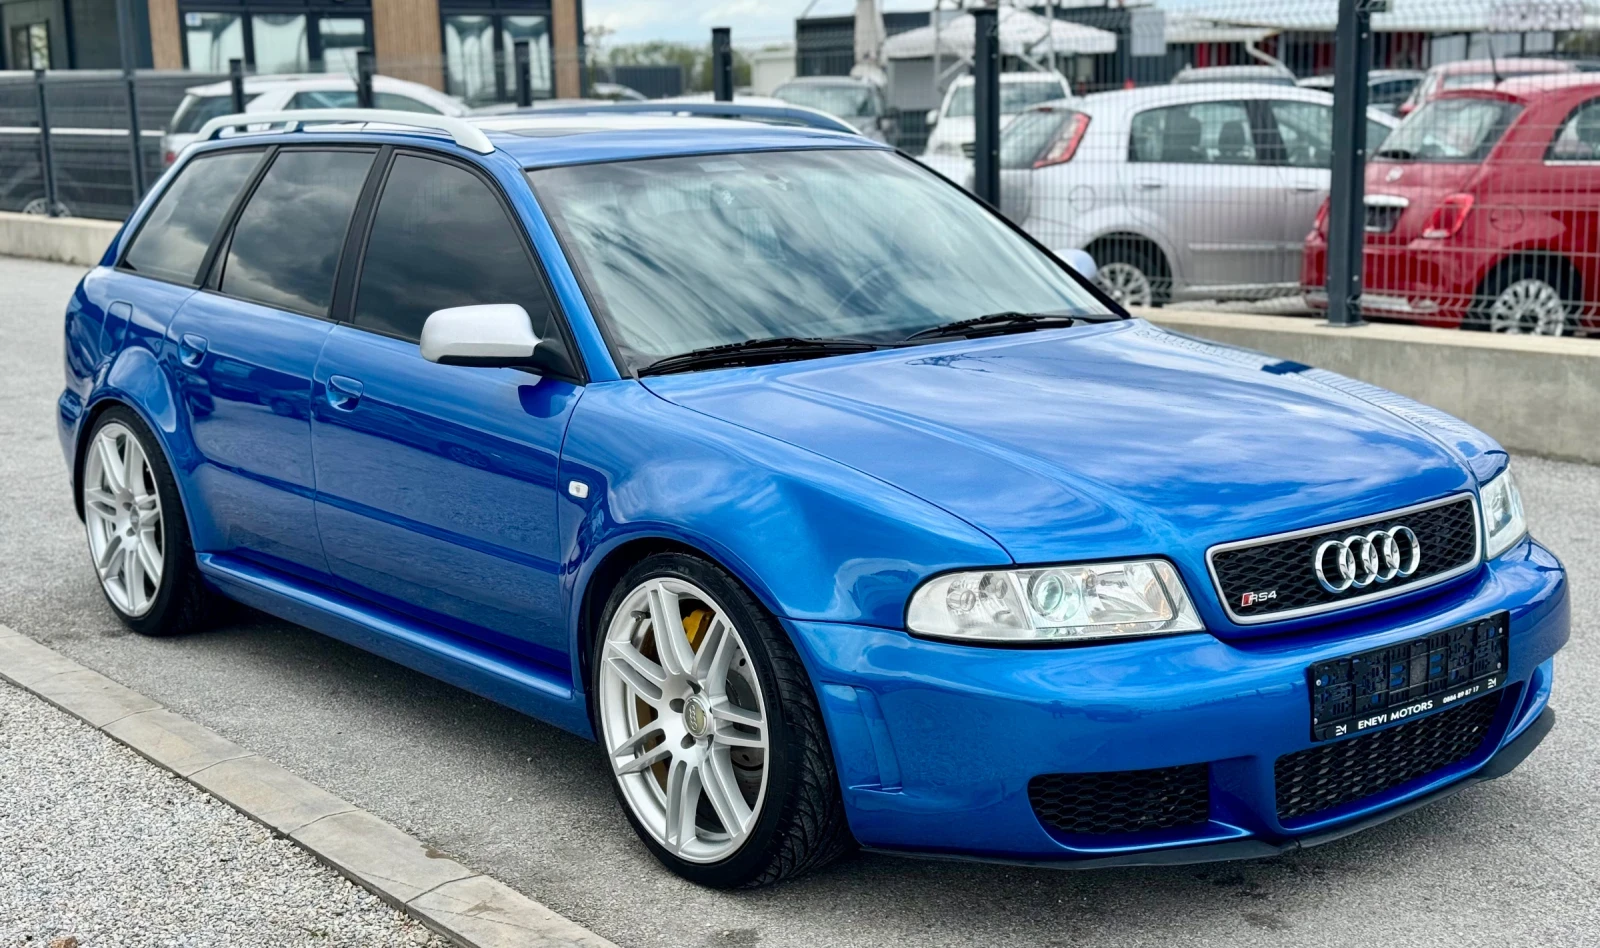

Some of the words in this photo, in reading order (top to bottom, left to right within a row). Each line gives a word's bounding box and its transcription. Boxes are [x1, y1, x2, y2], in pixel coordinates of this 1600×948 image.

[1246, 590, 1277, 605] RS4
[1358, 714, 1387, 730] ENEVI
[1390, 700, 1433, 721] MOTORS
[1473, 685, 1480, 693] 17
